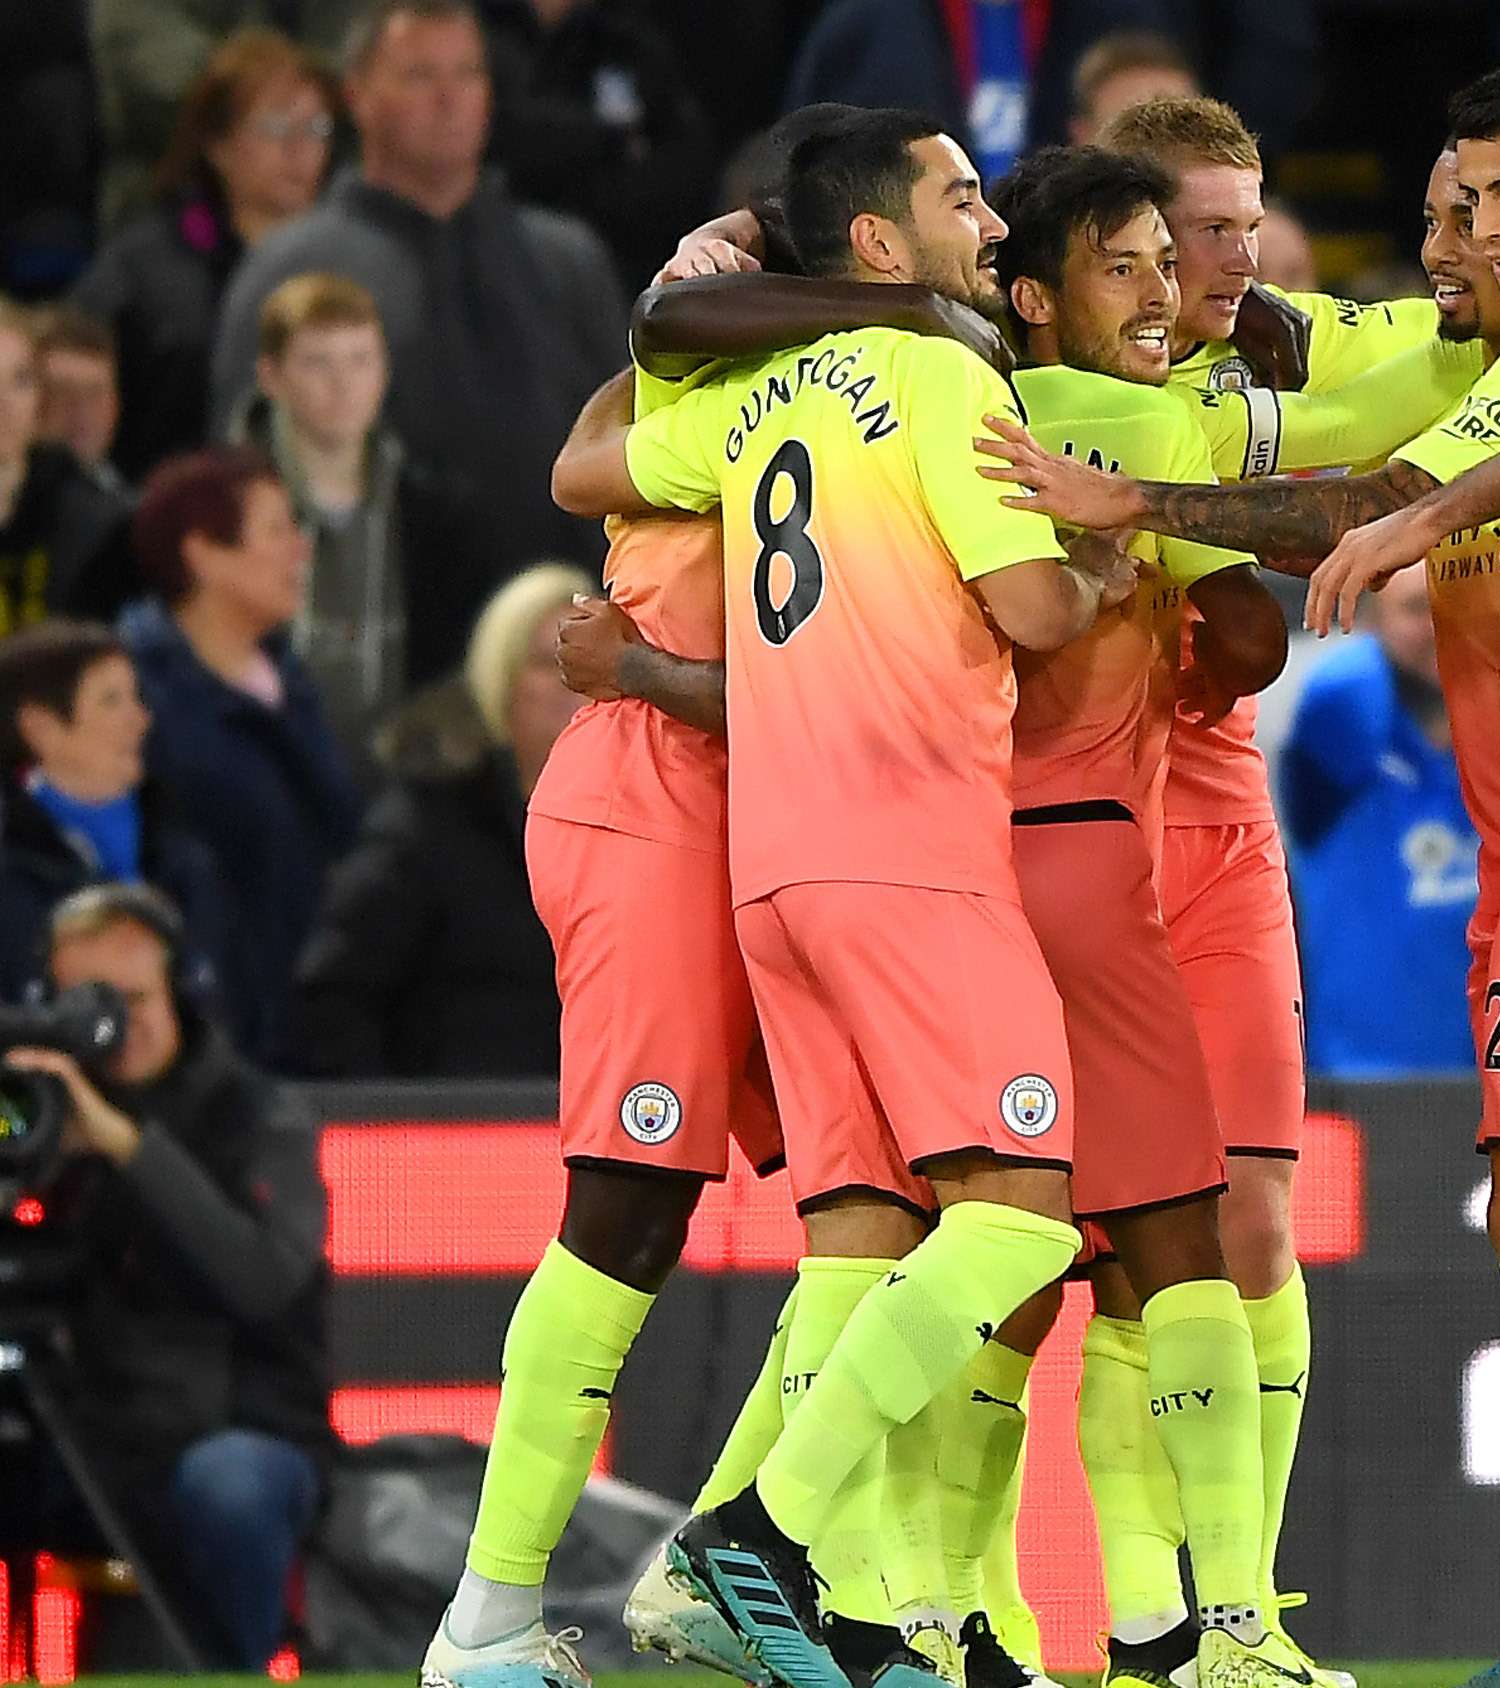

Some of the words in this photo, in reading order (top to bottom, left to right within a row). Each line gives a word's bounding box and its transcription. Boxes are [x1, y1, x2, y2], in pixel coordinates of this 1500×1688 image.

[753, 437, 826, 643] 8
[782, 1372, 819, 1394] CIT
[1150, 1388, 1215, 1416] CITY
